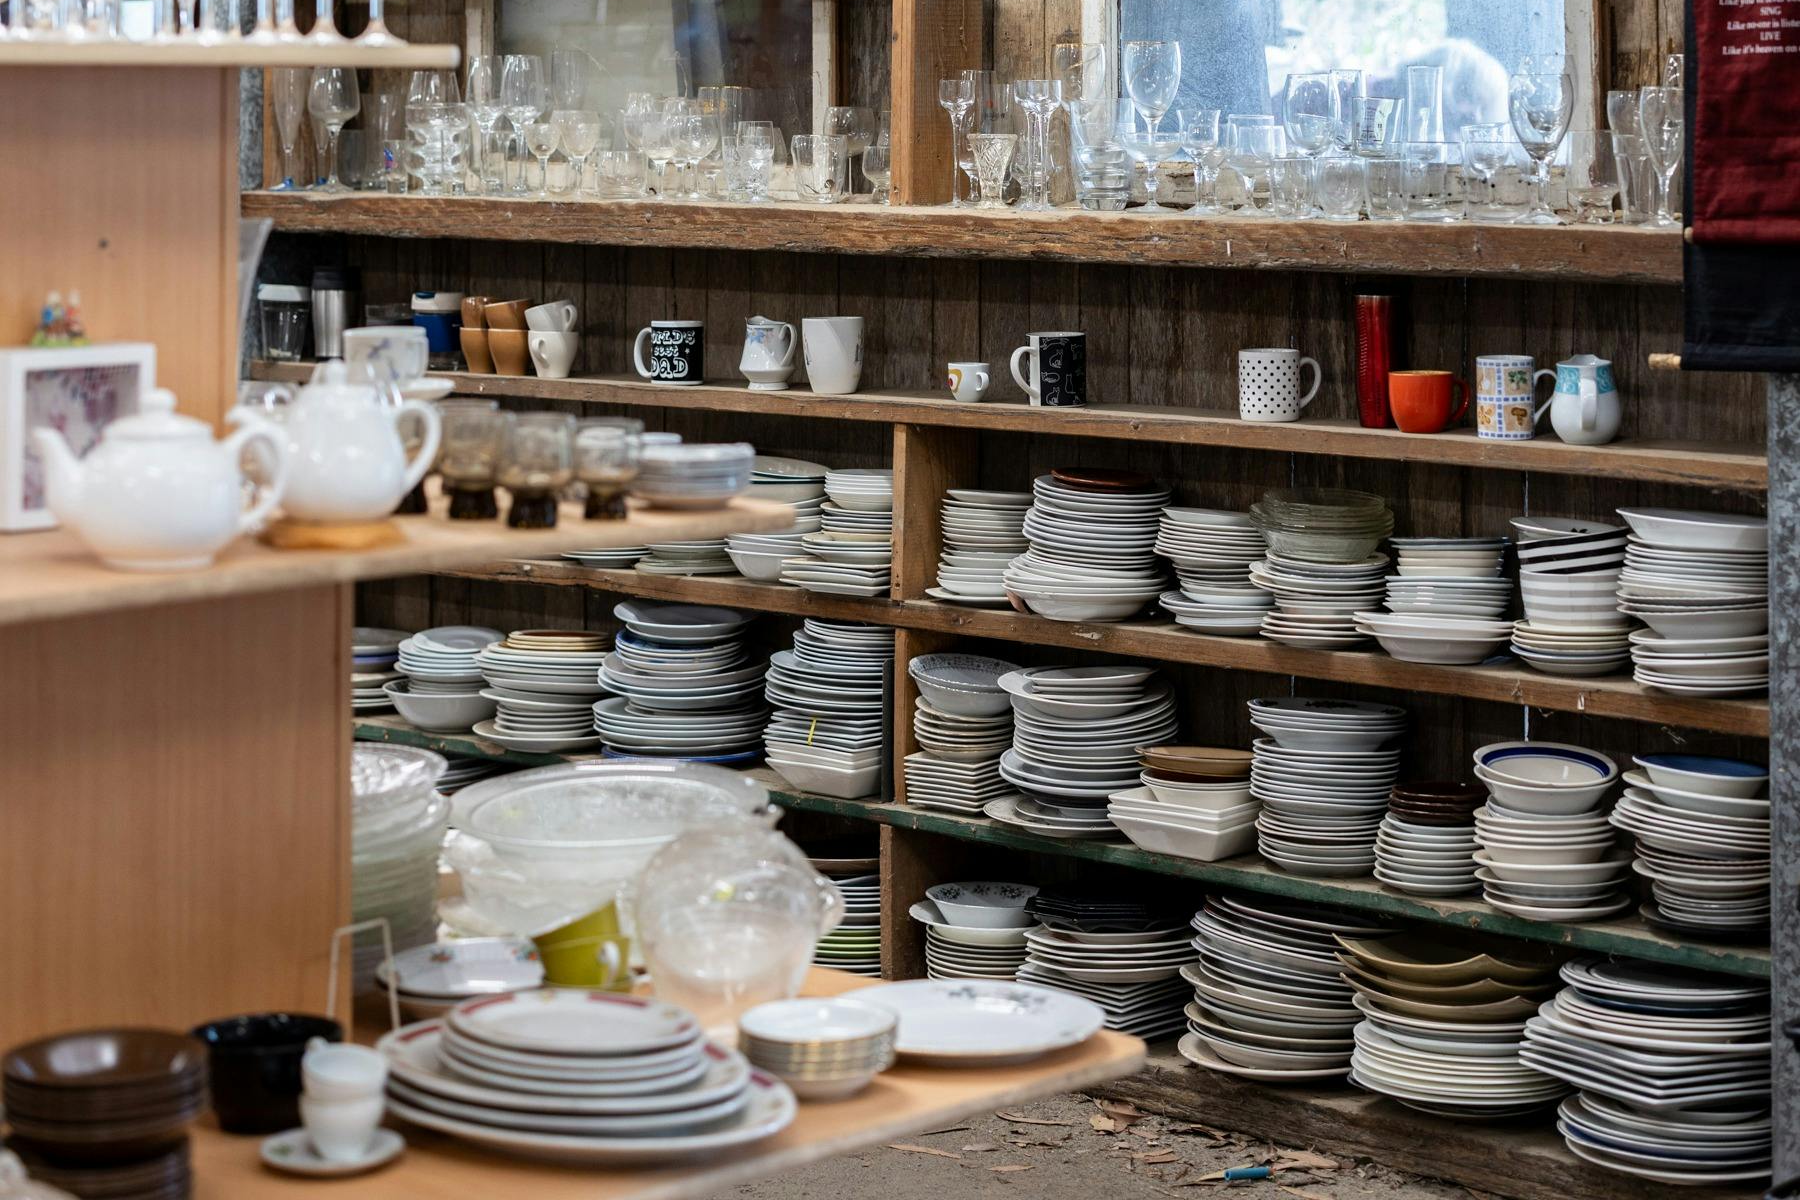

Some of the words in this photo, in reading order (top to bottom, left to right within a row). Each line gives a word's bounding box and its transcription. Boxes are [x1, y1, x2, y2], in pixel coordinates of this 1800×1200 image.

[1760, 7, 1782, 16] SING
[1727, 21, 1745, 31] Like
[1760, 31, 1781, 41] LIVE
[1722, 46, 1742, 55] Like
